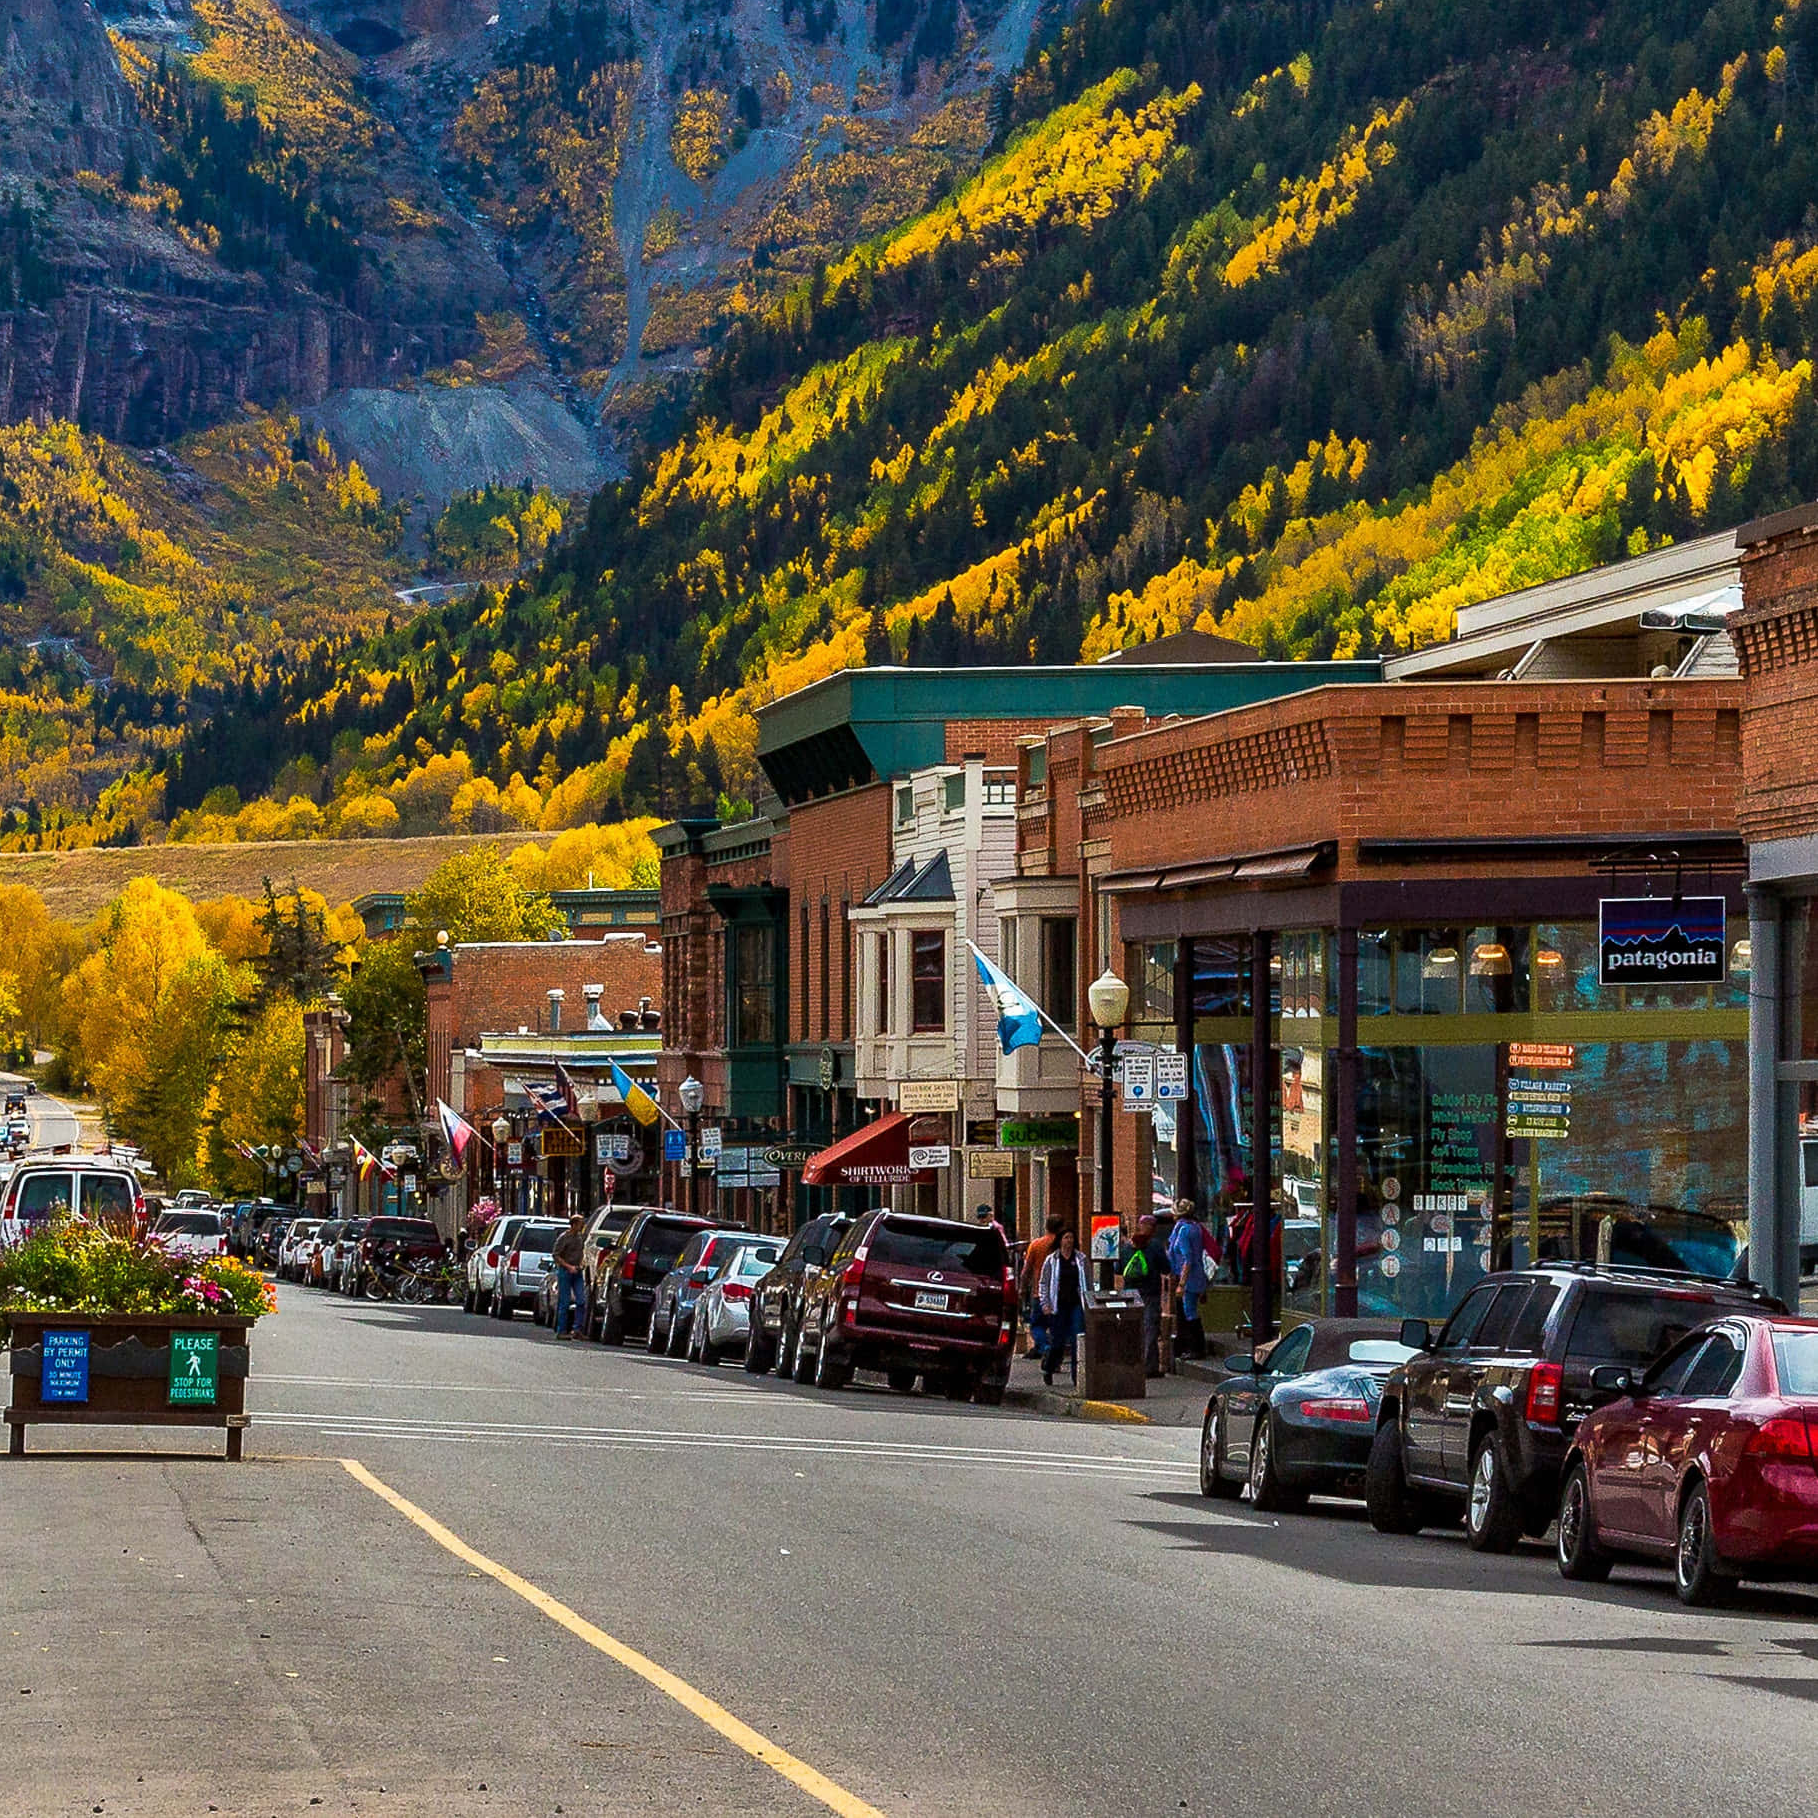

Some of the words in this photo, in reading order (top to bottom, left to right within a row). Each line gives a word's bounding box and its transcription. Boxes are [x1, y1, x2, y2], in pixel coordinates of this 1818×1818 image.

[1608, 948, 1718, 970] patagonia
[1008, 1125, 1076, 1143] sublime
[1431, 1128, 1446, 1142] Fly
[841, 1165, 920, 1177] SHIRTWORKS
[863, 1175, 911, 1183] TELLURIDE
[1414, 1195, 1468, 1211] BIKES
[48, 1337, 84, 1346] PARKING
[174, 1338, 214, 1350] PLEASE
[44, 1348, 56, 1357] BY
[58, 1348, 87, 1357] PERMIT
[55, 1358, 76, 1368] ONLY
[174, 1377, 194, 1387] STOP
[196, 1377, 213, 1387] FOR
[170, 1388, 215, 1399] PEDESTRIANS
